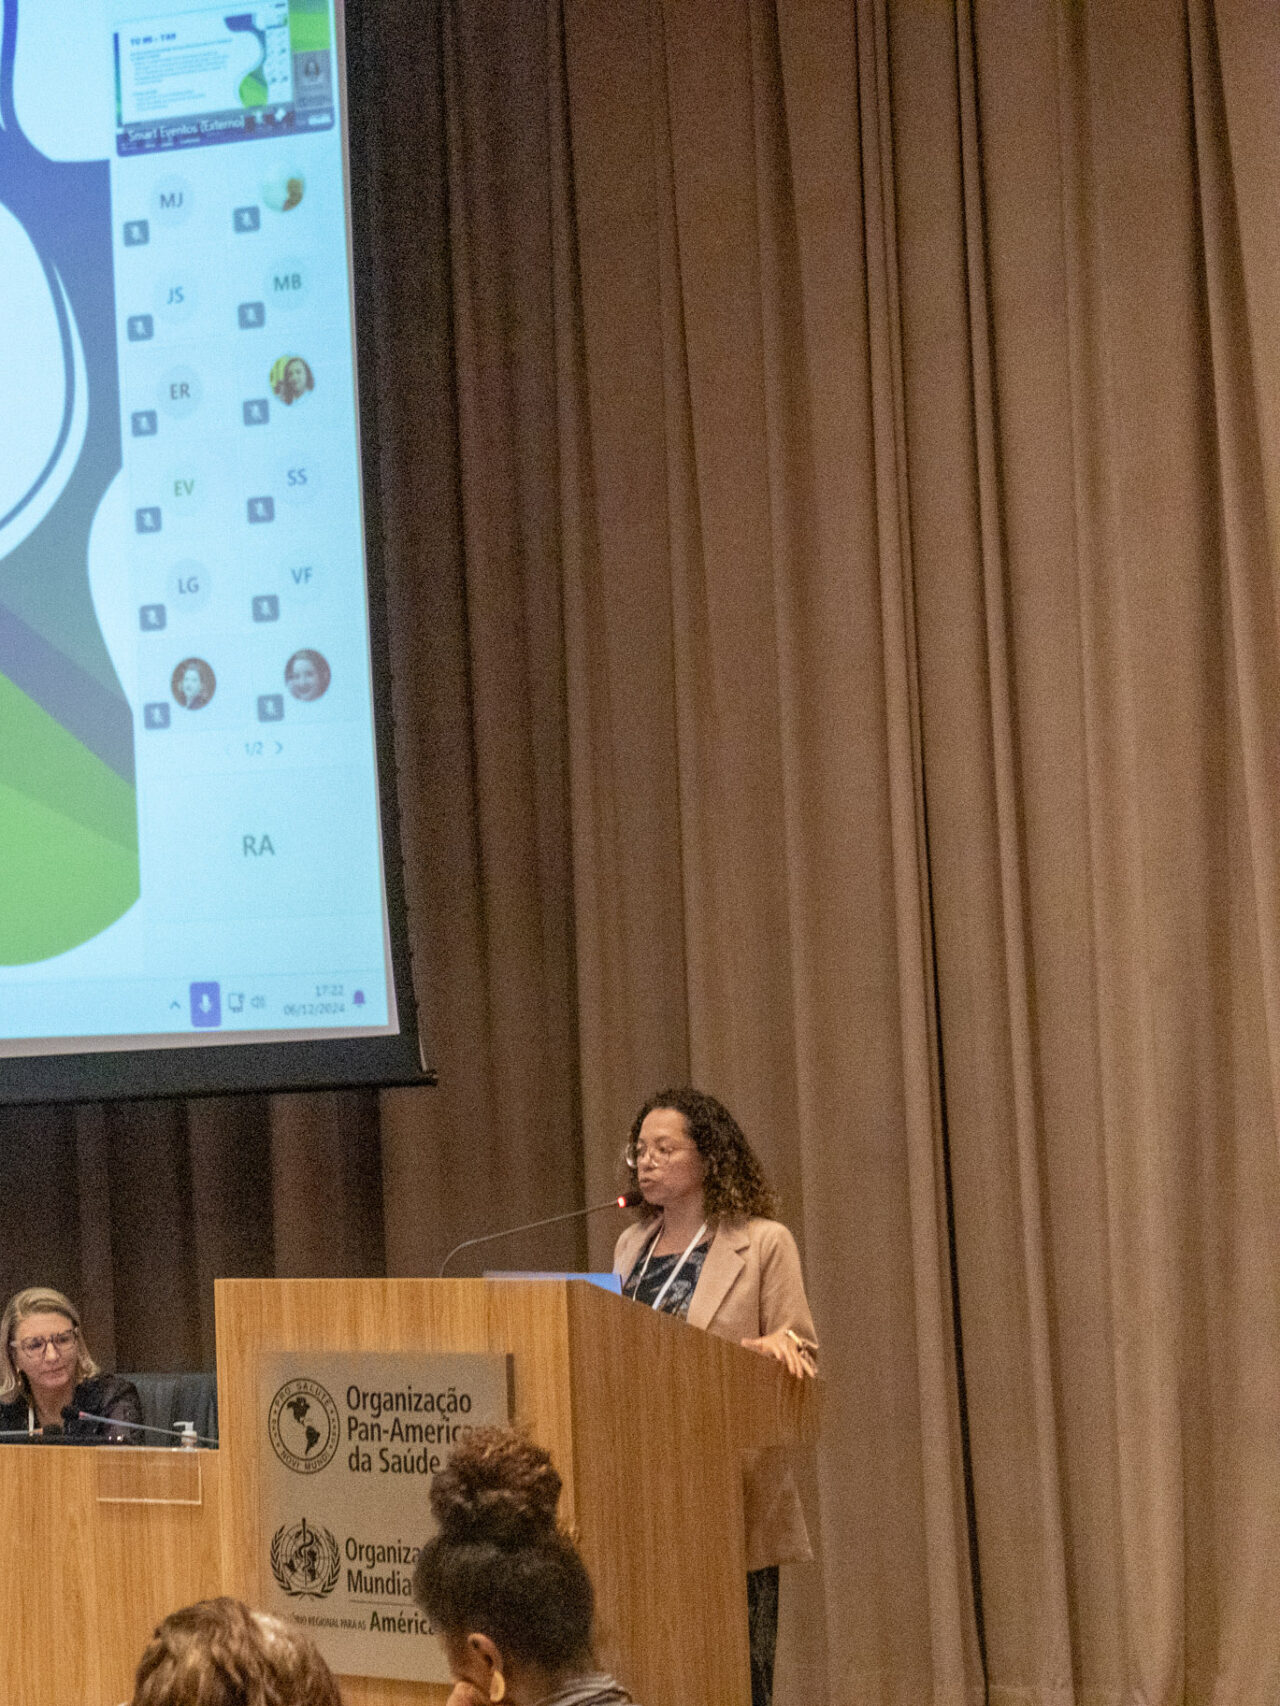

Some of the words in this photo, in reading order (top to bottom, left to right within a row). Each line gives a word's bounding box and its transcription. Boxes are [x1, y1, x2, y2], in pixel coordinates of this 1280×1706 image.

[160, 192, 184, 209] MJ
[273, 274, 302, 292] MB
[166, 287, 184, 304] JS
[170, 382, 191, 401] ER
[287, 468, 309, 487] SS
[173, 480, 195, 498] EV
[178, 576, 200, 594] LG
[291, 566, 314, 585] VF
[243, 834, 276, 858] RA
[345, 1385, 472, 1419] Organização
[348, 1445, 372, 1473] da
[379, 1447, 441, 1475] Saúde
[345, 1537, 422, 1569] Organiza
[346, 1567, 413, 1598] Mundia
[369, 1610, 434, 1636] Améric
